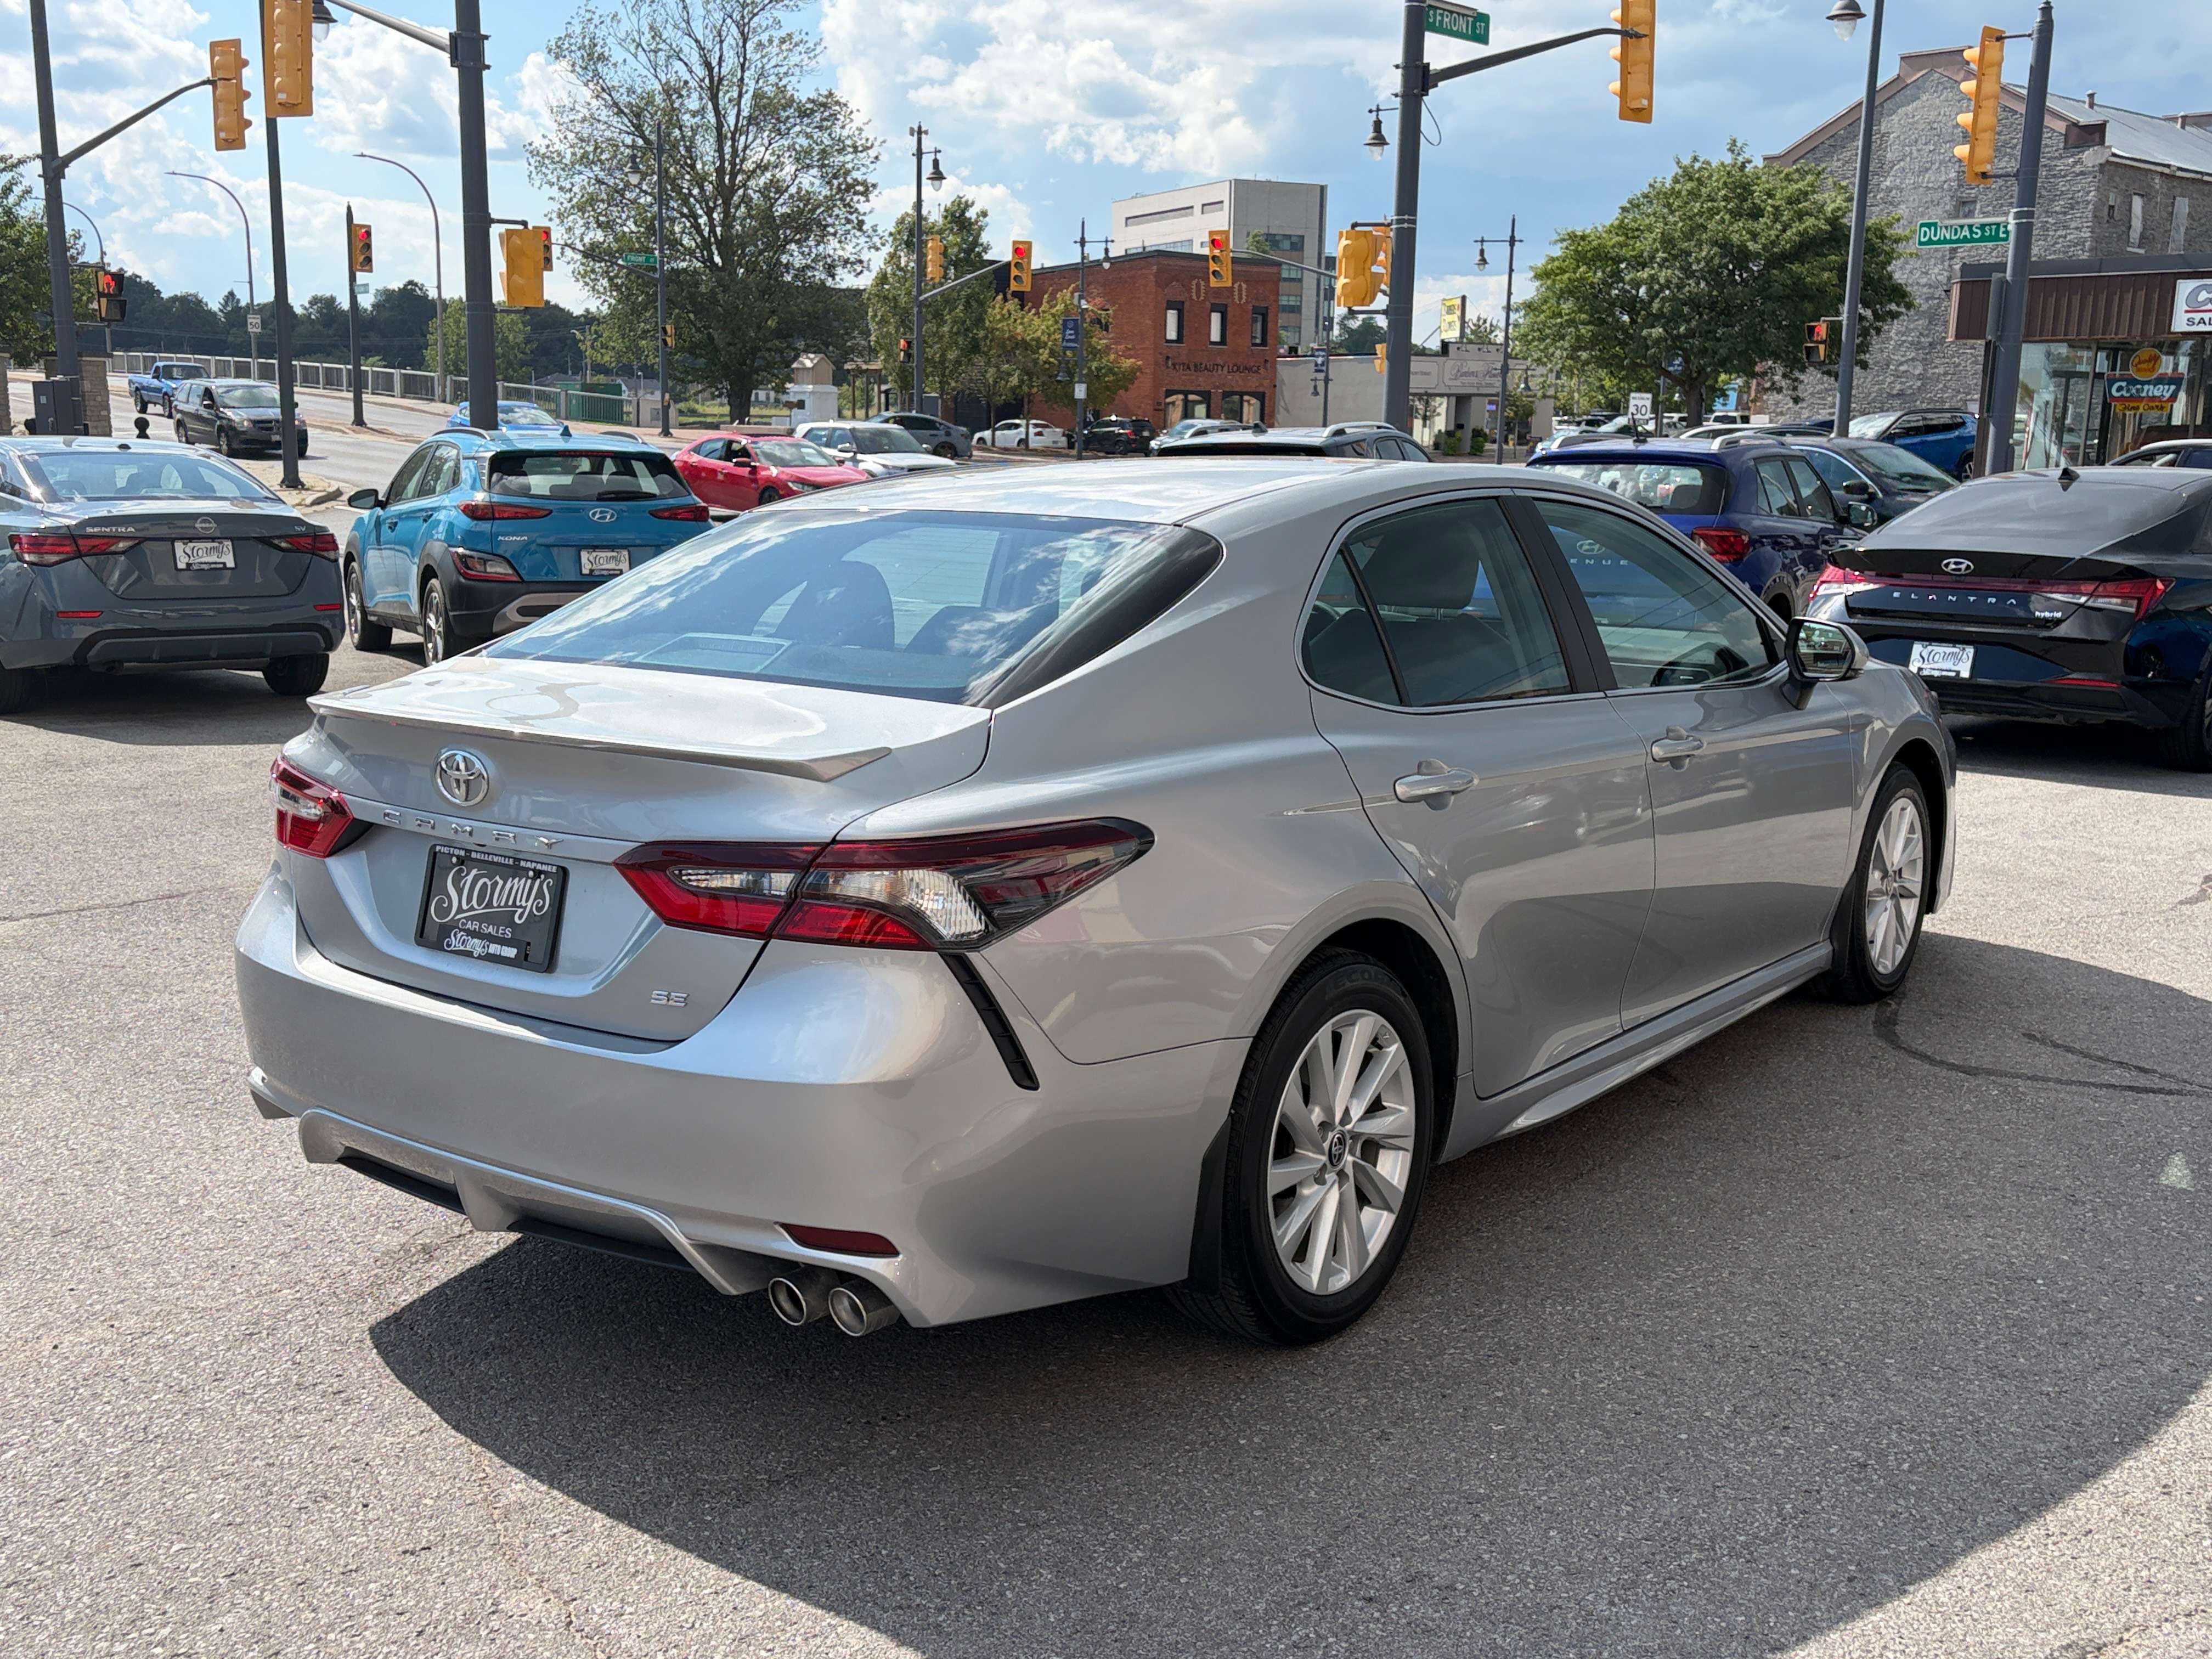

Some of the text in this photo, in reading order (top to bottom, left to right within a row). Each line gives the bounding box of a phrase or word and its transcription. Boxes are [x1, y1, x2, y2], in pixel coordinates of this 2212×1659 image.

[1429, 9, 1485, 35] S FRONT ST
[1920, 223, 2007, 242] DUNDAS ST E
[250, 321, 259, 330] 50
[1193, 362, 1226, 373] BEAUTY
[1227, 363, 1261, 374] LOUNGE
[2112, 381, 2176, 400] Cooney
[1632, 404, 1648, 416] 30
[1893, 591, 2017, 605] ELANTRA
[2035, 610, 2062, 619] hybrid
[383, 809, 565, 850] CAMRY
[436, 845, 558, 873] PICTON BELLEVILLE NAPANEE
[431, 865, 553, 924] Stormy's
[459, 919, 512, 939] CAR SALES
[650, 990, 690, 1007] SE
